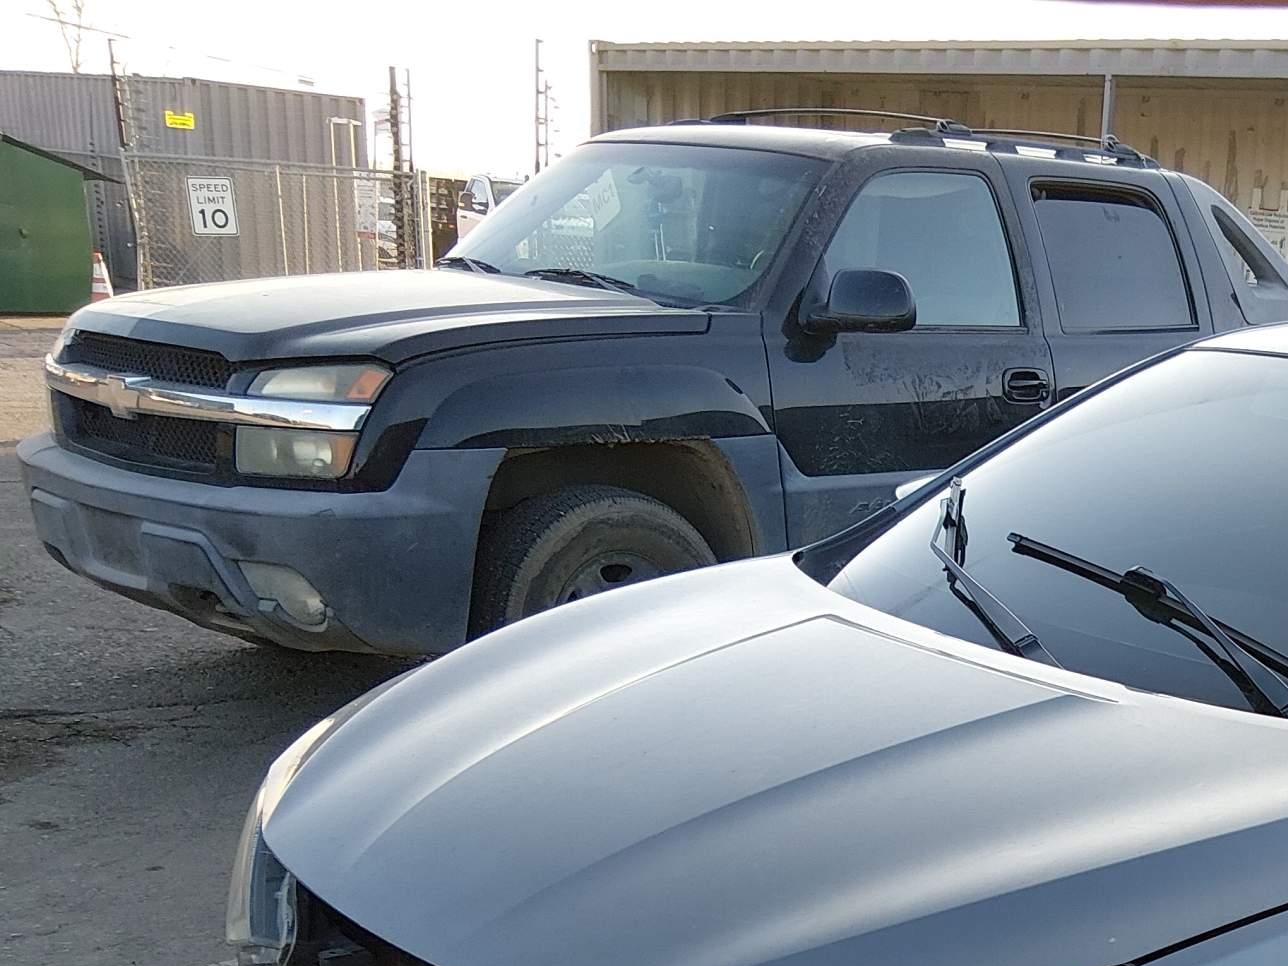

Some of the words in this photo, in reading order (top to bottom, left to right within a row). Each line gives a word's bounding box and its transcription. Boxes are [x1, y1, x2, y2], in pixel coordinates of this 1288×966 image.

[191, 183, 229, 193] SPEED
[196, 195, 226, 205] LIMIT
[198, 208, 229, 229] 10
